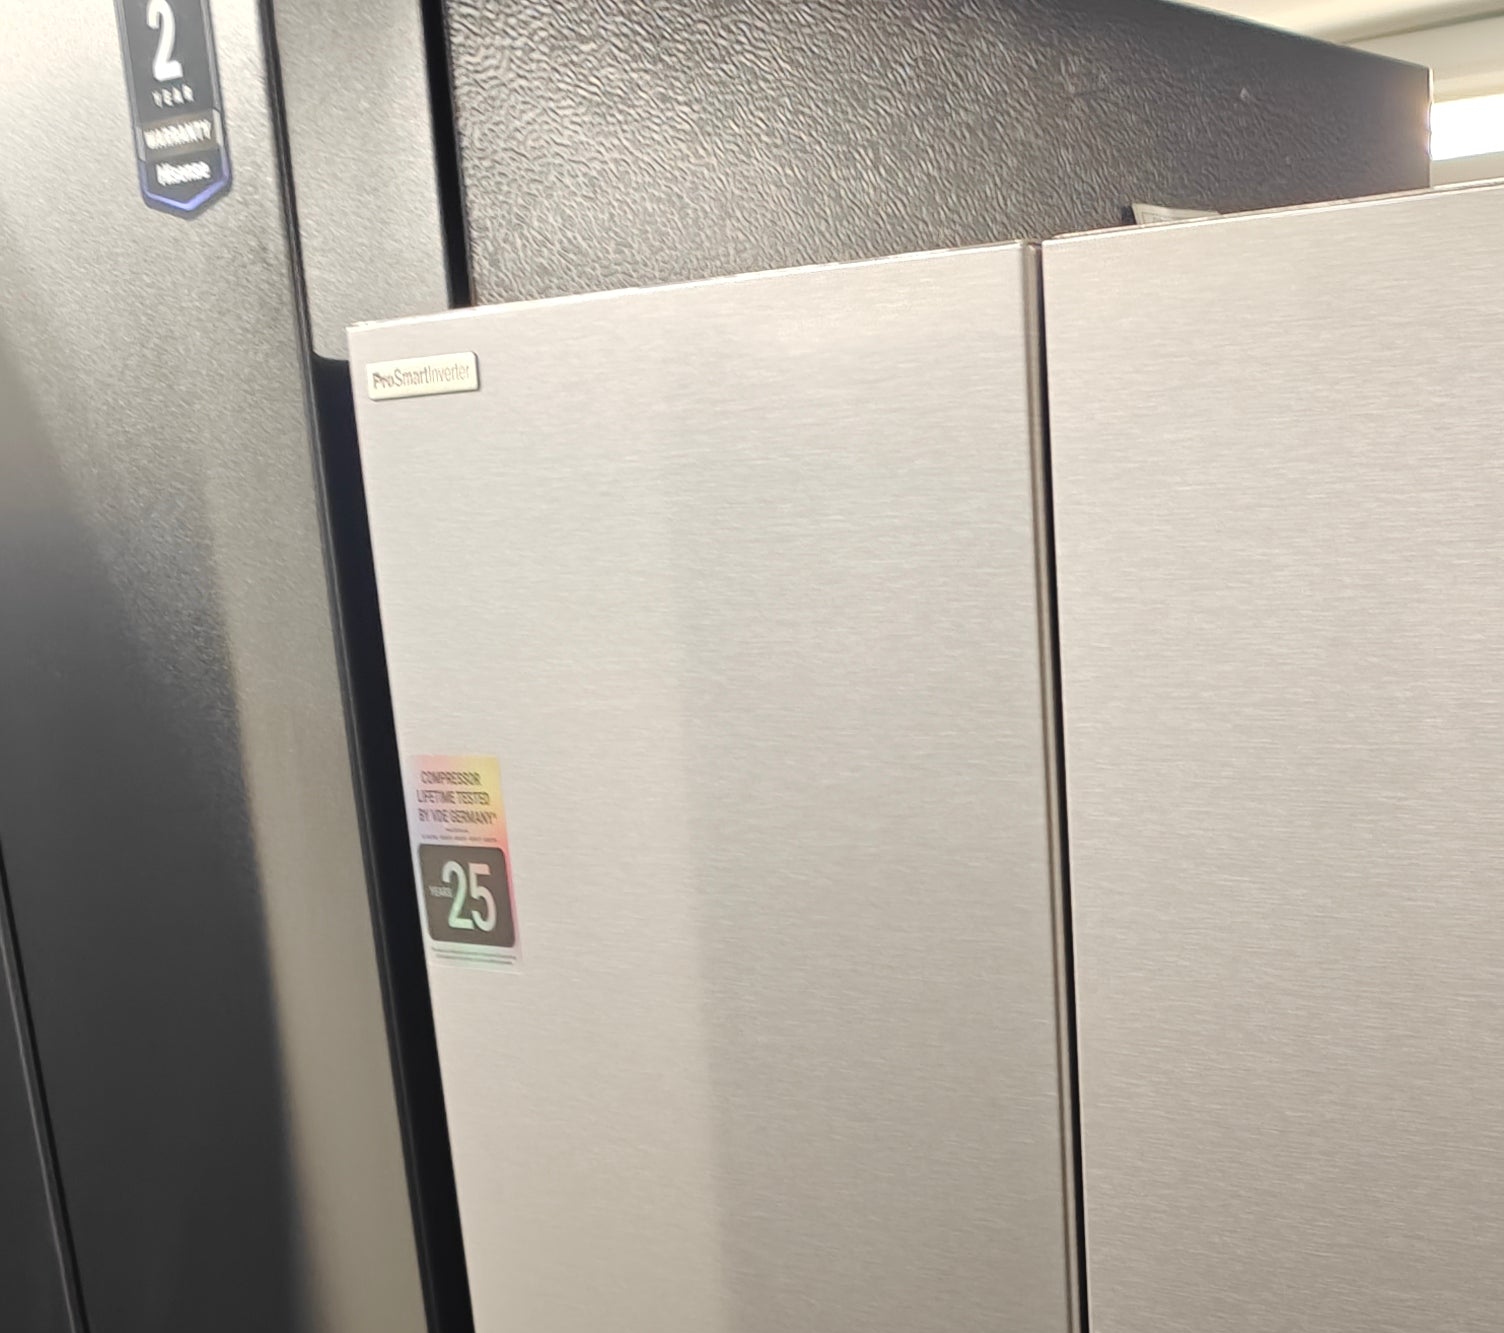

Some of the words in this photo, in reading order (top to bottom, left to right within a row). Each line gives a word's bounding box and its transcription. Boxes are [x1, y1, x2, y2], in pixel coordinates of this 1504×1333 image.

[146, 0, 184, 82] 2
[152, 84, 195, 109] YEAR
[144, 119, 212, 150] WARRANTY
[156, 161, 211, 187] Hisense
[372, 363, 470, 390] ProSmartInverter
[420, 770, 482, 786] COMPRESSOR
[416, 789, 456, 805] LIFETIME
[456, 791, 490, 806] TESTED
[418, 808, 431, 822] BY
[442, 860, 497, 932] 25
